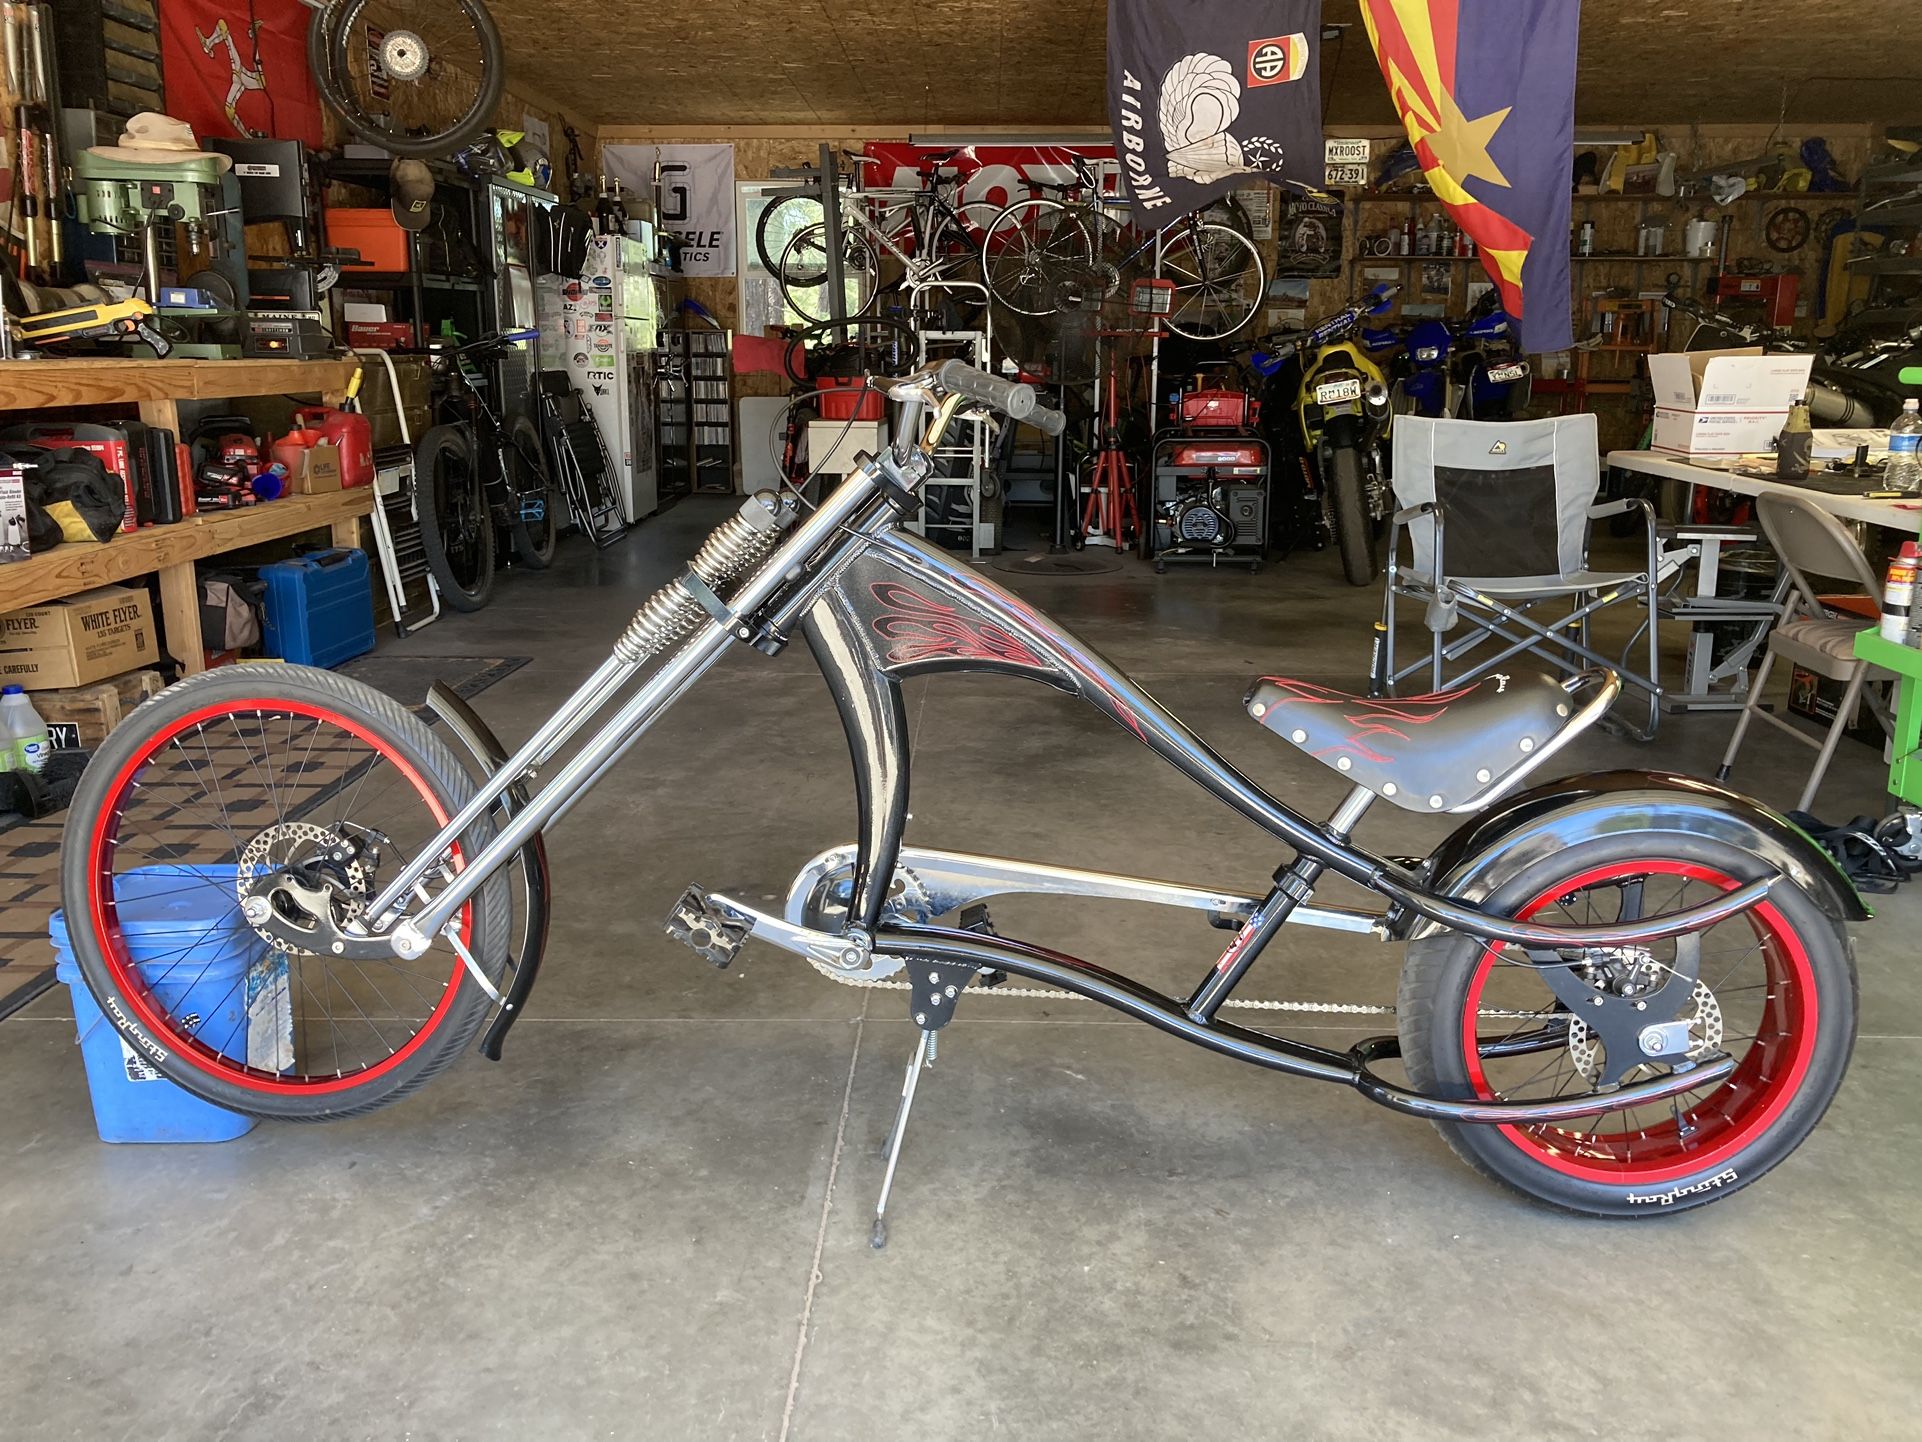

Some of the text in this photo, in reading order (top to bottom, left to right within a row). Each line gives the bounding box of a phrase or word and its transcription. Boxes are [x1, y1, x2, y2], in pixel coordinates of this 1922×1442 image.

[1254, 45, 1285, 77] AA
[1121, 69, 1173, 210] AIRBORNE
[1328, 145, 1367, 157] MXROOST
[351, 324, 380, 333] Bauer
[587, 371, 614, 380] RTIC
[6, 617, 38, 631] FLYER
[80, 604, 140, 632] WHITE FLYER
[108, 624, 131, 636] TARGETS
[3, 663, 39, 675] CAREFULLY
